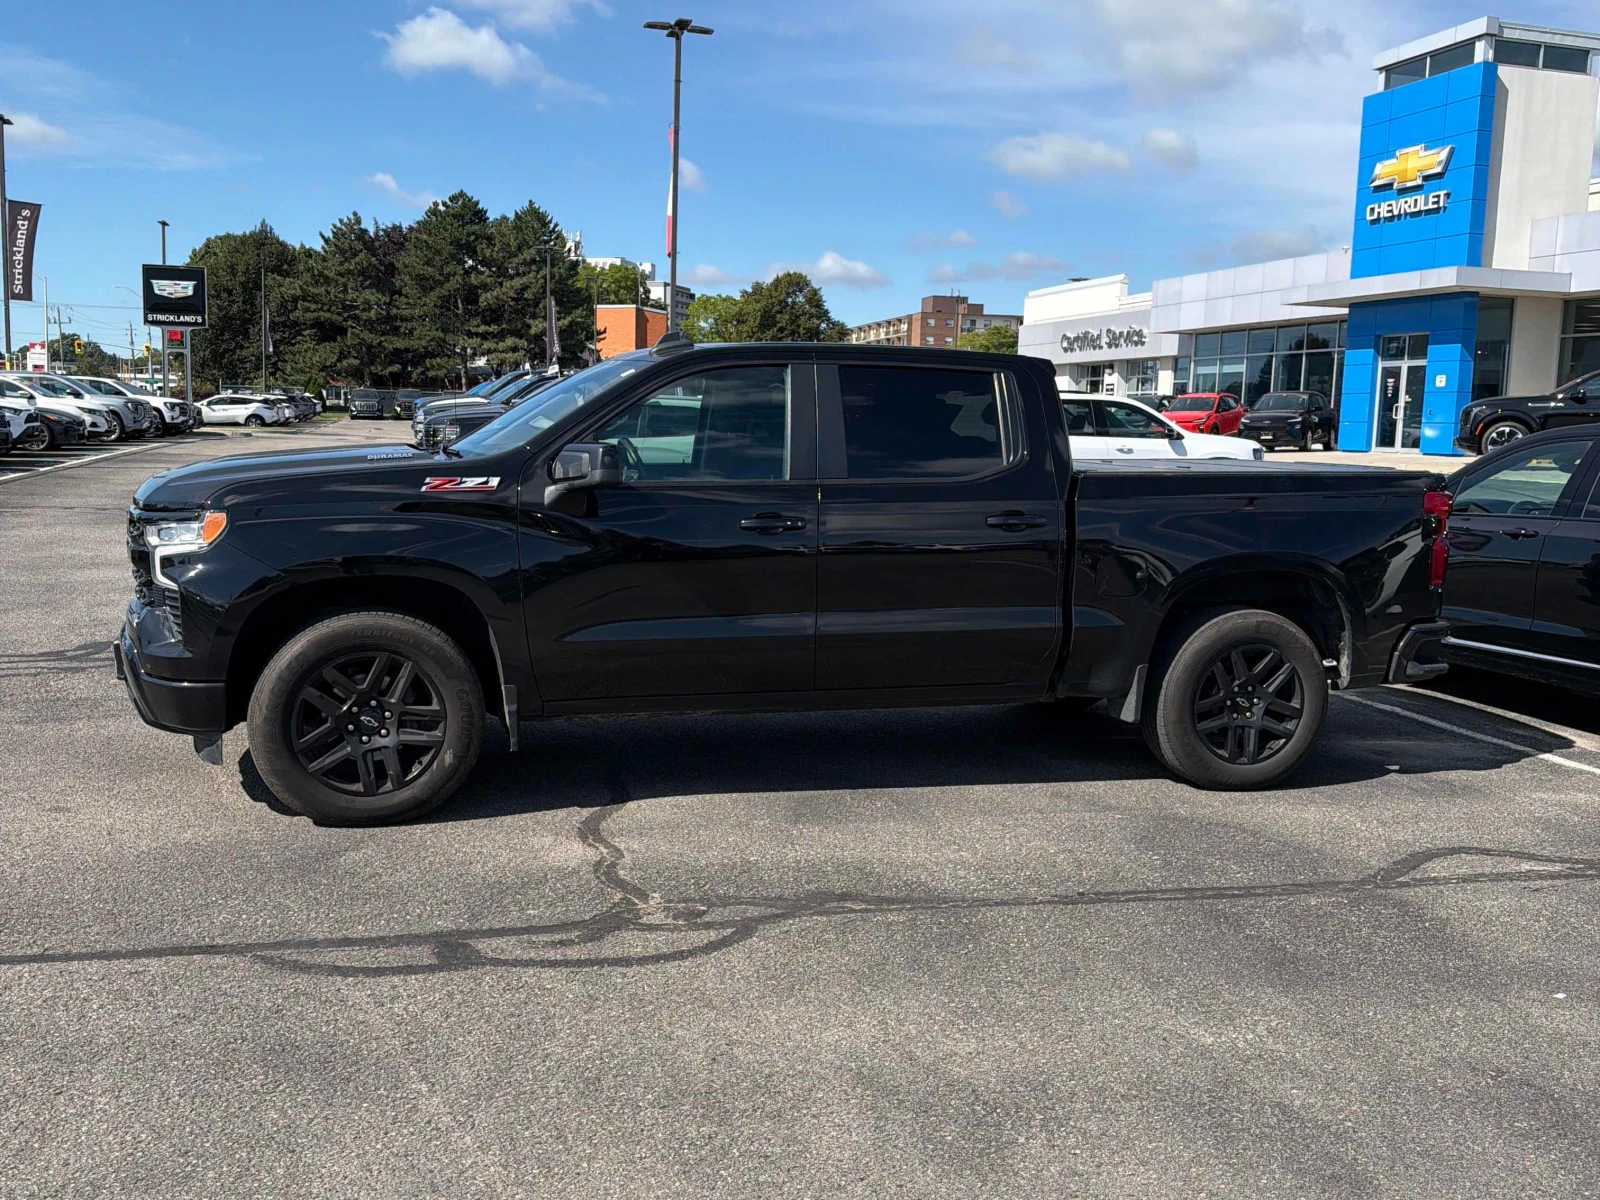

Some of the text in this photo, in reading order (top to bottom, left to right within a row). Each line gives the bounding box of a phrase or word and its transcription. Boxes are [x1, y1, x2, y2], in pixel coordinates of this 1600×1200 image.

[1366, 190, 1448, 221] CHEVROLET
[13, 209, 31, 295] Strickland's
[147, 313, 203, 323] STRICKLAND'S
[1061, 325, 1147, 354] Certified Service
[367, 452, 414, 461] DURAMAX
[420, 476, 502, 492] Z71
